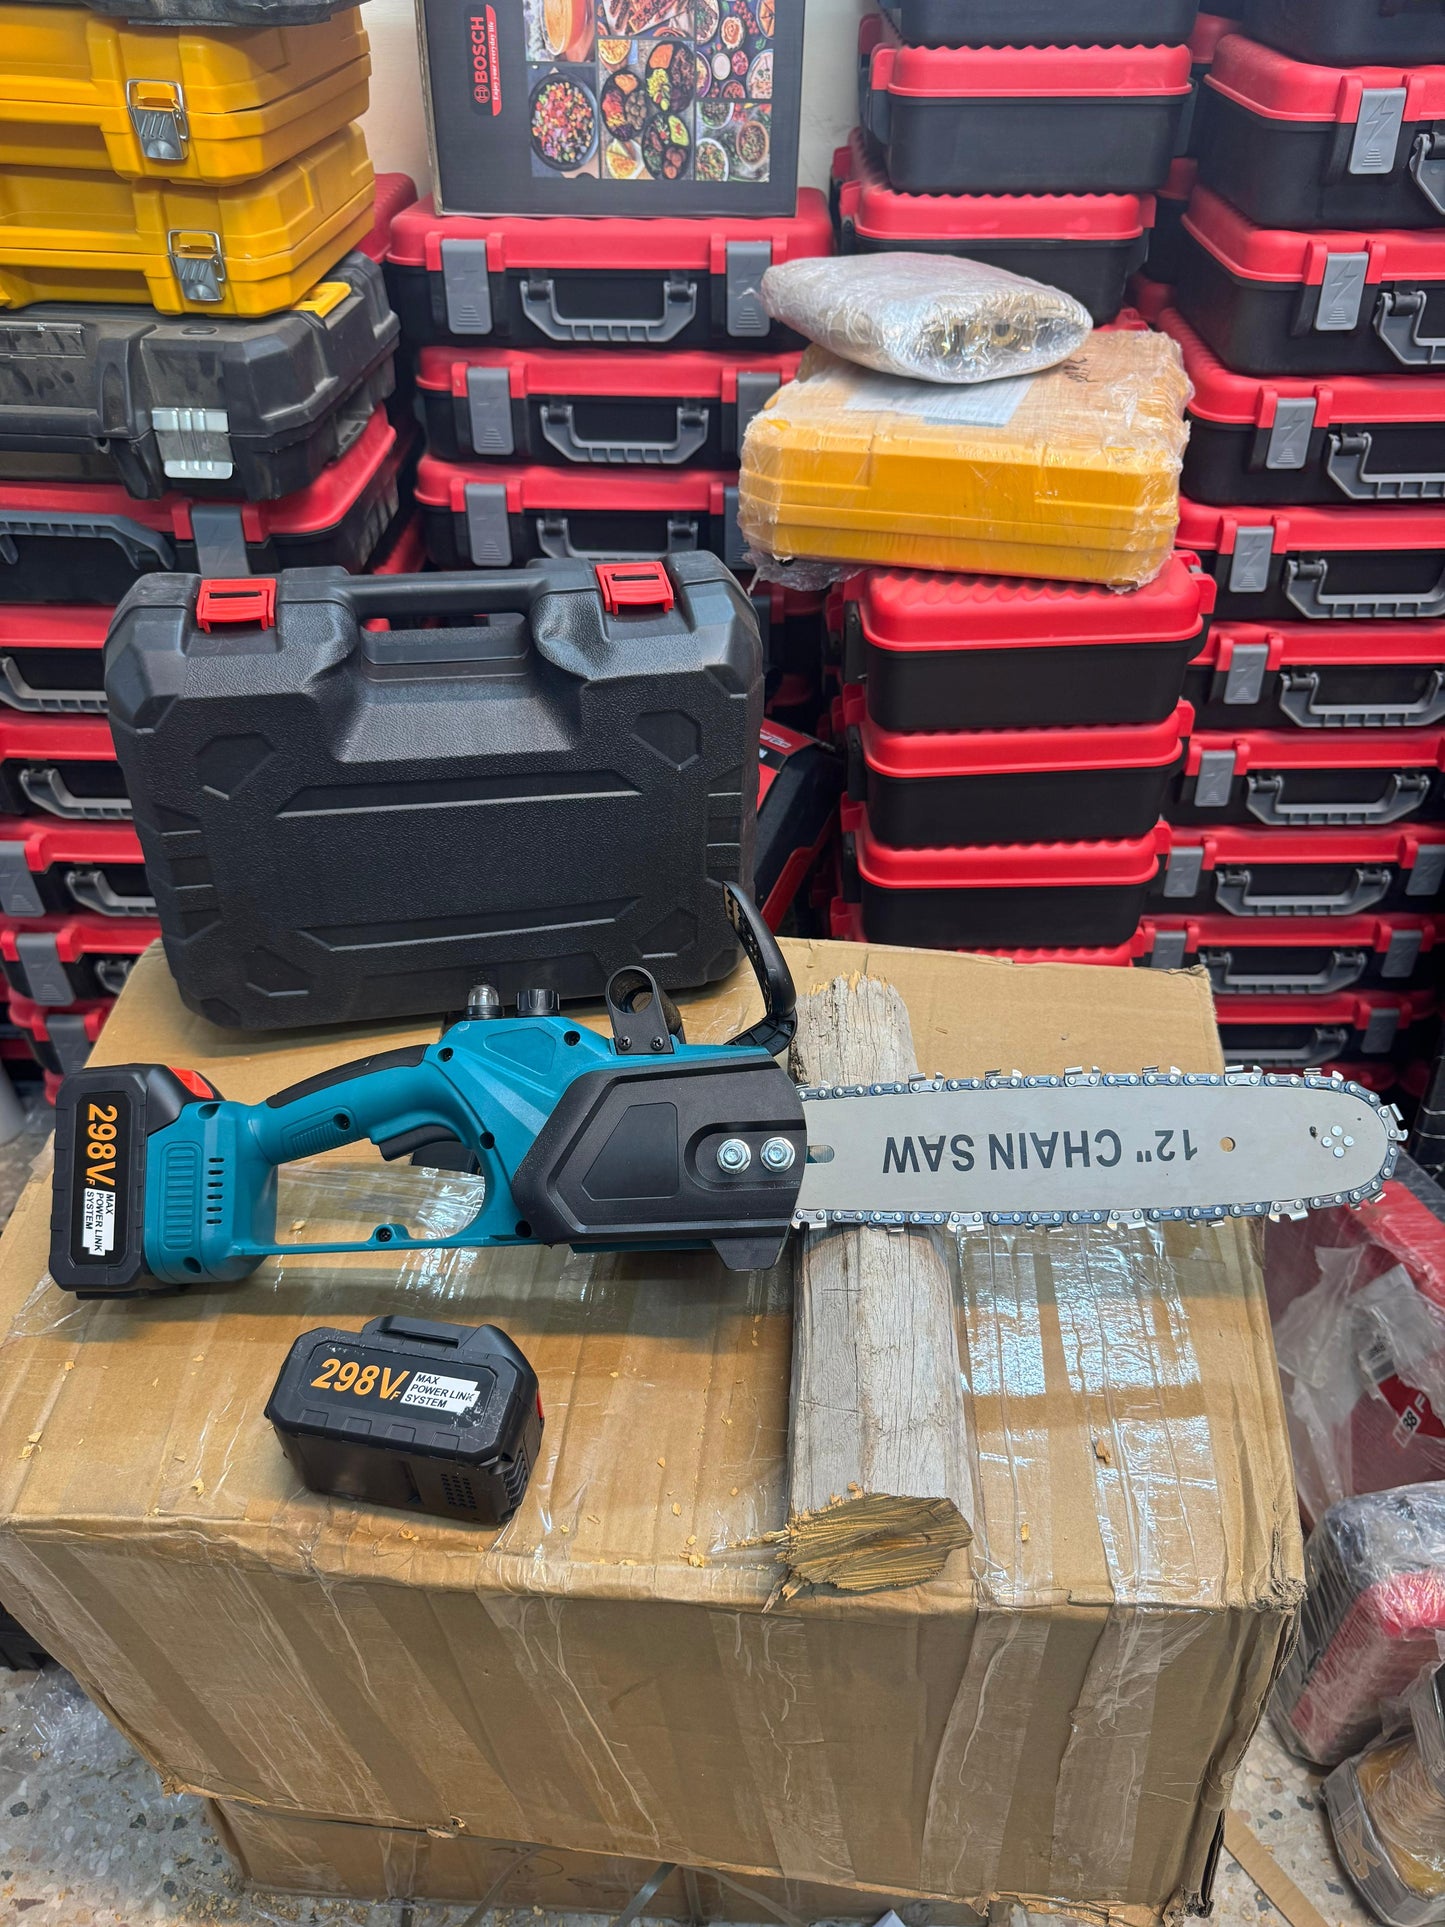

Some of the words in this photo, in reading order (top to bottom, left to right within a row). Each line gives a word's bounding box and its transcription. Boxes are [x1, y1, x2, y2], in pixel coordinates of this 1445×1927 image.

[470, 16, 489, 84] BOSCH
[489, 34, 498, 64] everyday
[491, 65, 499, 81] your
[492, 83, 500, 101] Enjoy
[882, 1133, 975, 1174] SAW
[988, 1128, 1122, 1171] CHAIN
[1136, 1129, 1198, 1163] 12"
[85, 1190, 95, 1230] SYSTEM
[94, 1192, 104, 1226] POWER
[105, 1193, 114, 1215] MAX
[94, 1228, 103, 1252] LINK
[410, 1384, 449, 1398] POWER
[449, 1391, 474, 1402] LINK
[415, 1374, 440, 1385] MAX
[404, 1394, 448, 1409] SYSTEM
